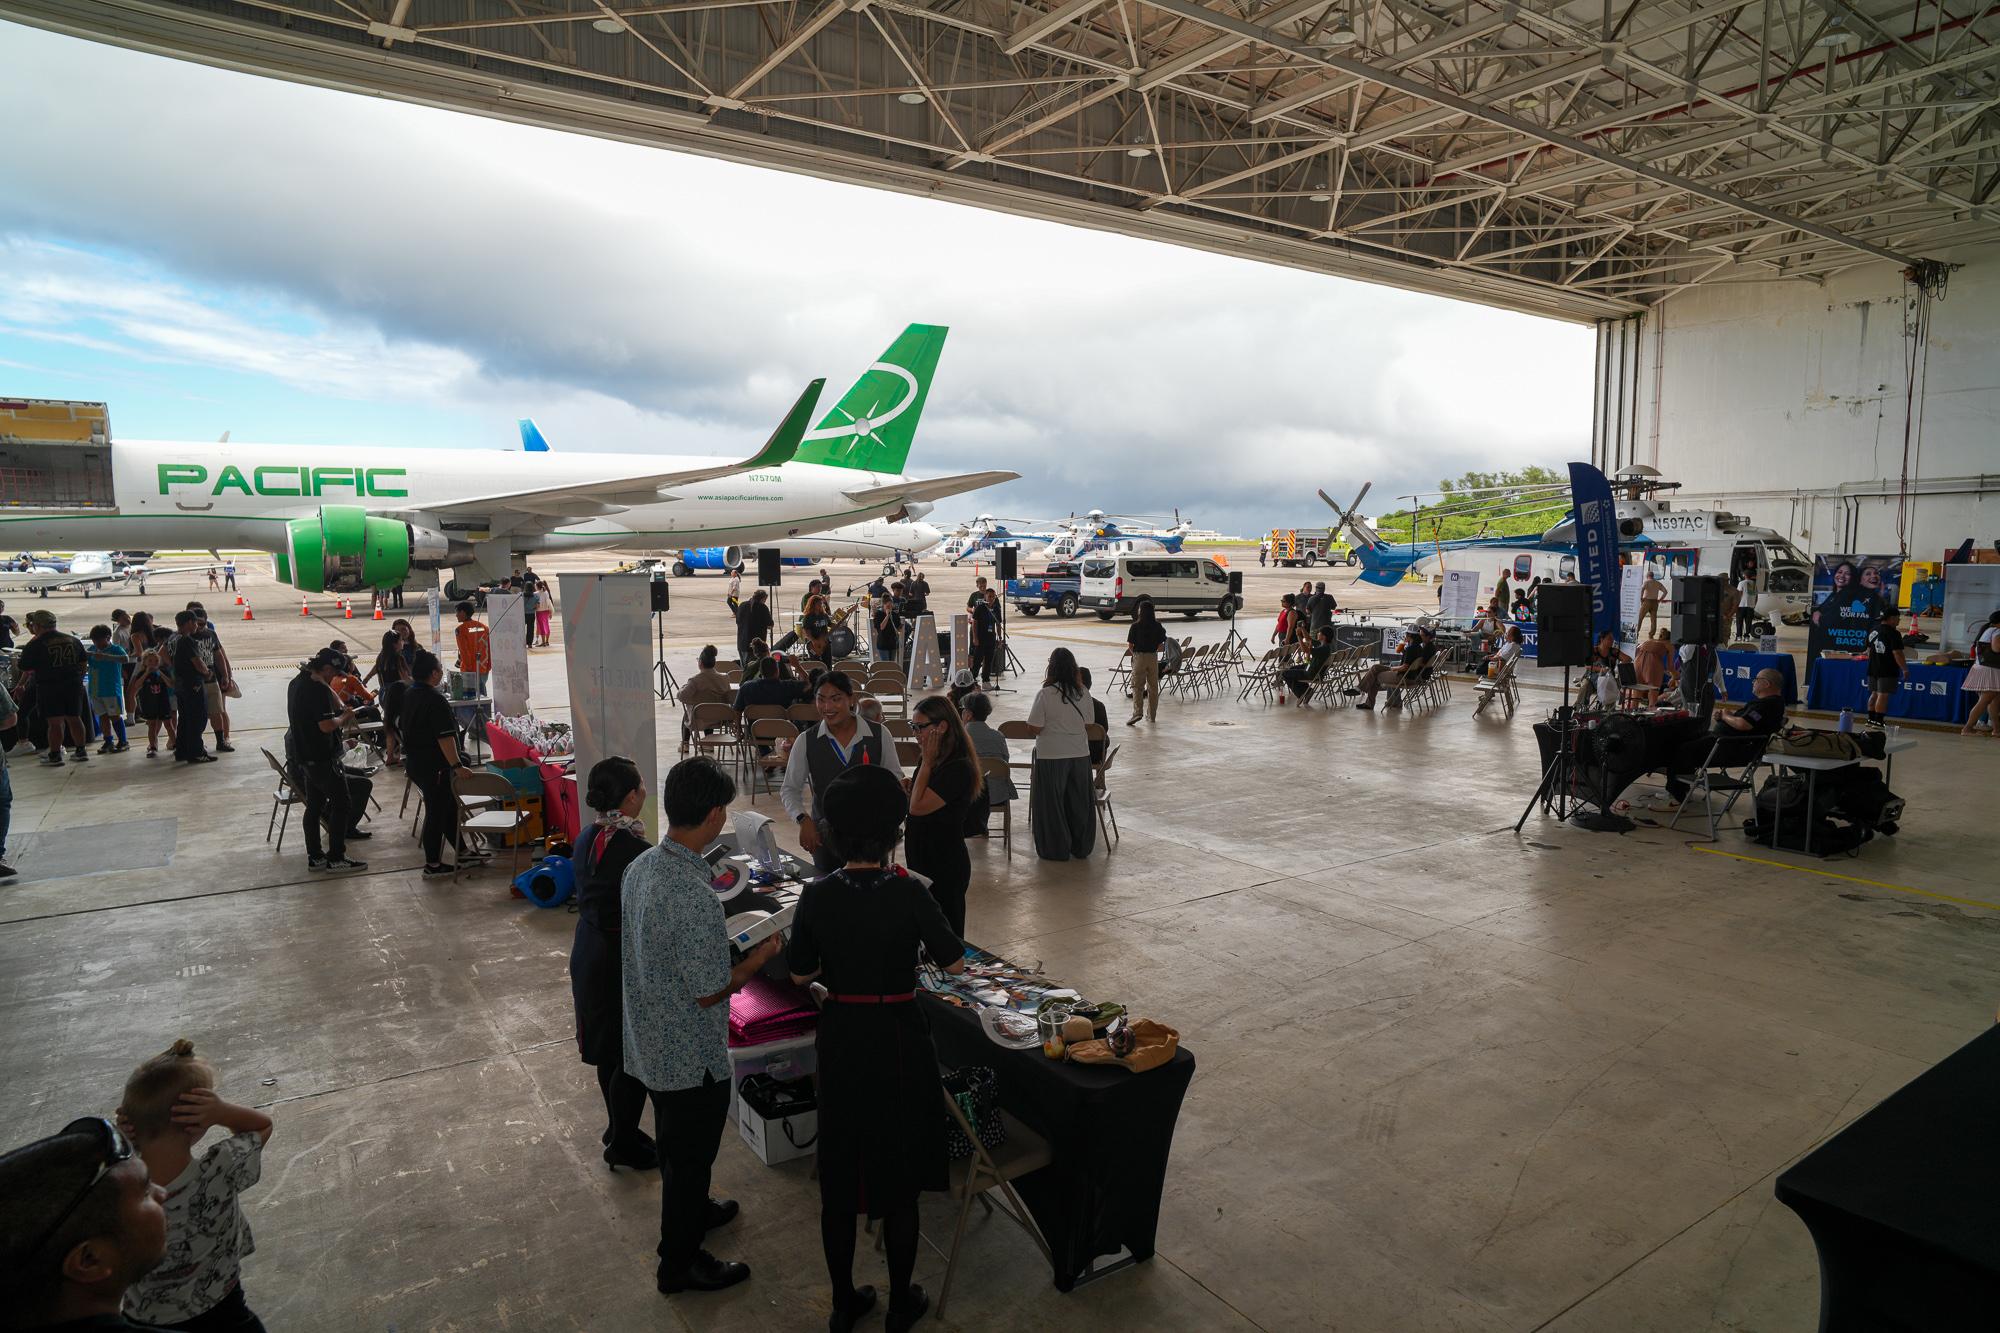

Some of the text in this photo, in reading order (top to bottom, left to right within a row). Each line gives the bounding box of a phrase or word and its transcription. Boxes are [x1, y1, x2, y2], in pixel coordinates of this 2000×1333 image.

[157, 464, 408, 497] PACIFIC
[697, 494, 783, 502] www.asiapacificairlines.com
[1653, 516, 1703, 530] N597AC
[1587, 528, 1605, 613] UNITED
[1828, 628, 1868, 638] WELCO
[1835, 637, 1865, 646] BACK
